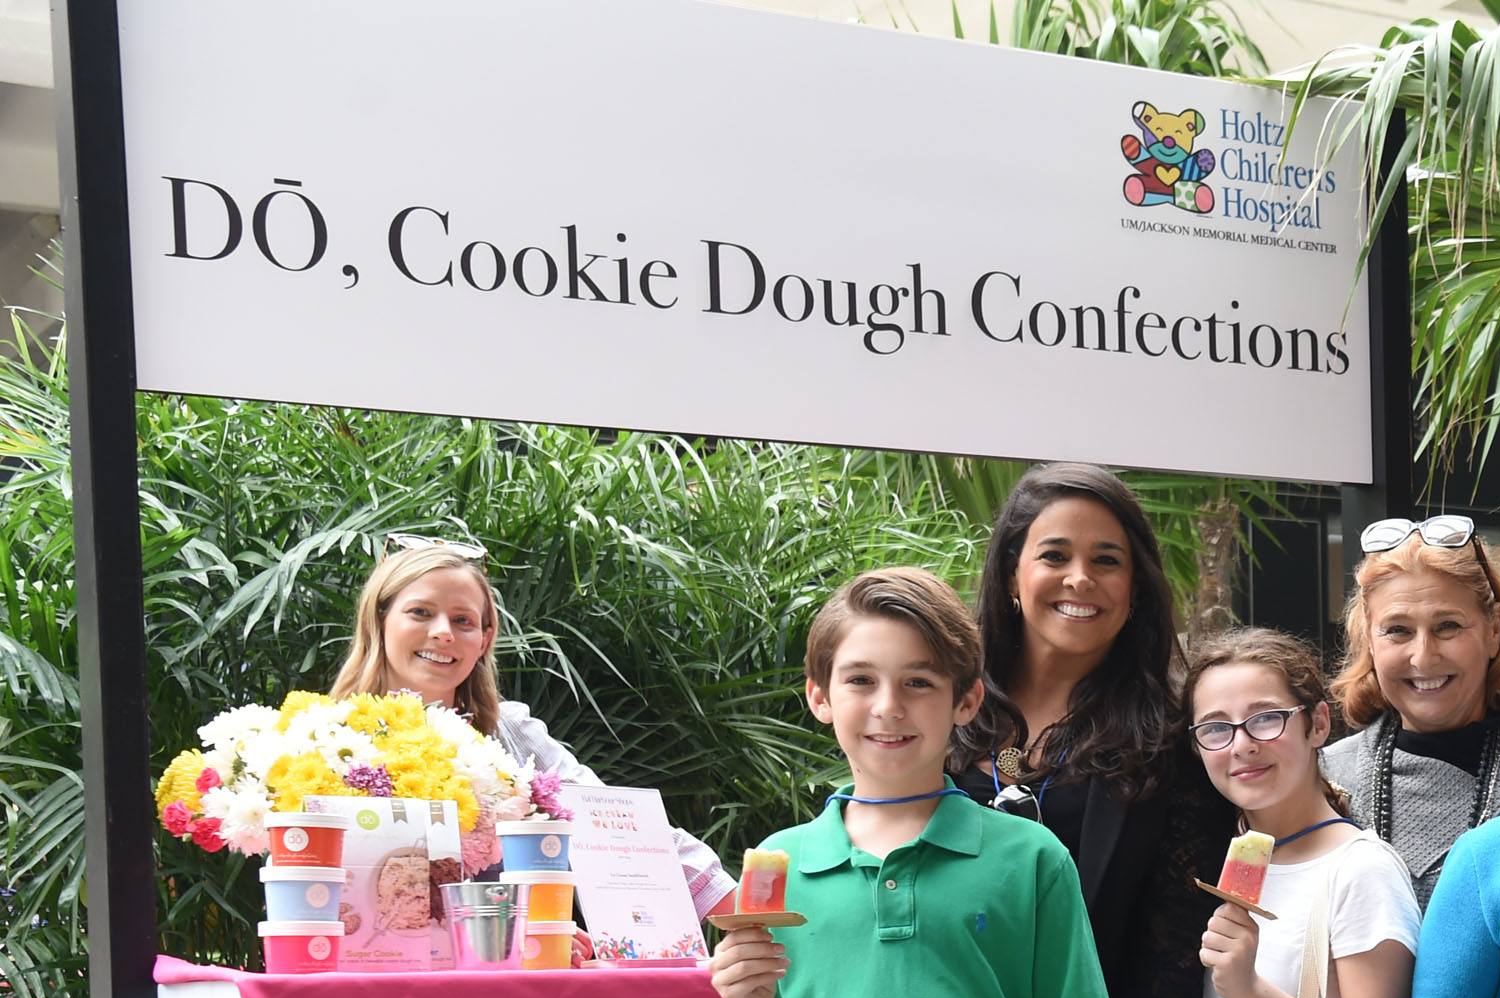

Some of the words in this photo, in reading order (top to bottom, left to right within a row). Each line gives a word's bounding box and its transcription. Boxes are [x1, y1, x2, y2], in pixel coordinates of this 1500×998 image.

[1220, 108, 1286, 148] Holtz
[1220, 148, 1336, 193] Childrens
[1222, 187, 1321, 232] Hospital
[1120, 218, 1190, 236] UM/JACKSON
[1193, 227, 1249, 244] MEMORIAL
[1250, 235, 1297, 250] MEDICAL
[1298, 240, 1337, 254] CENTER
[387, 206, 679, 309] Cookie
[700, 239, 952, 355] Dough
[970, 270, 1351, 376] Confections
